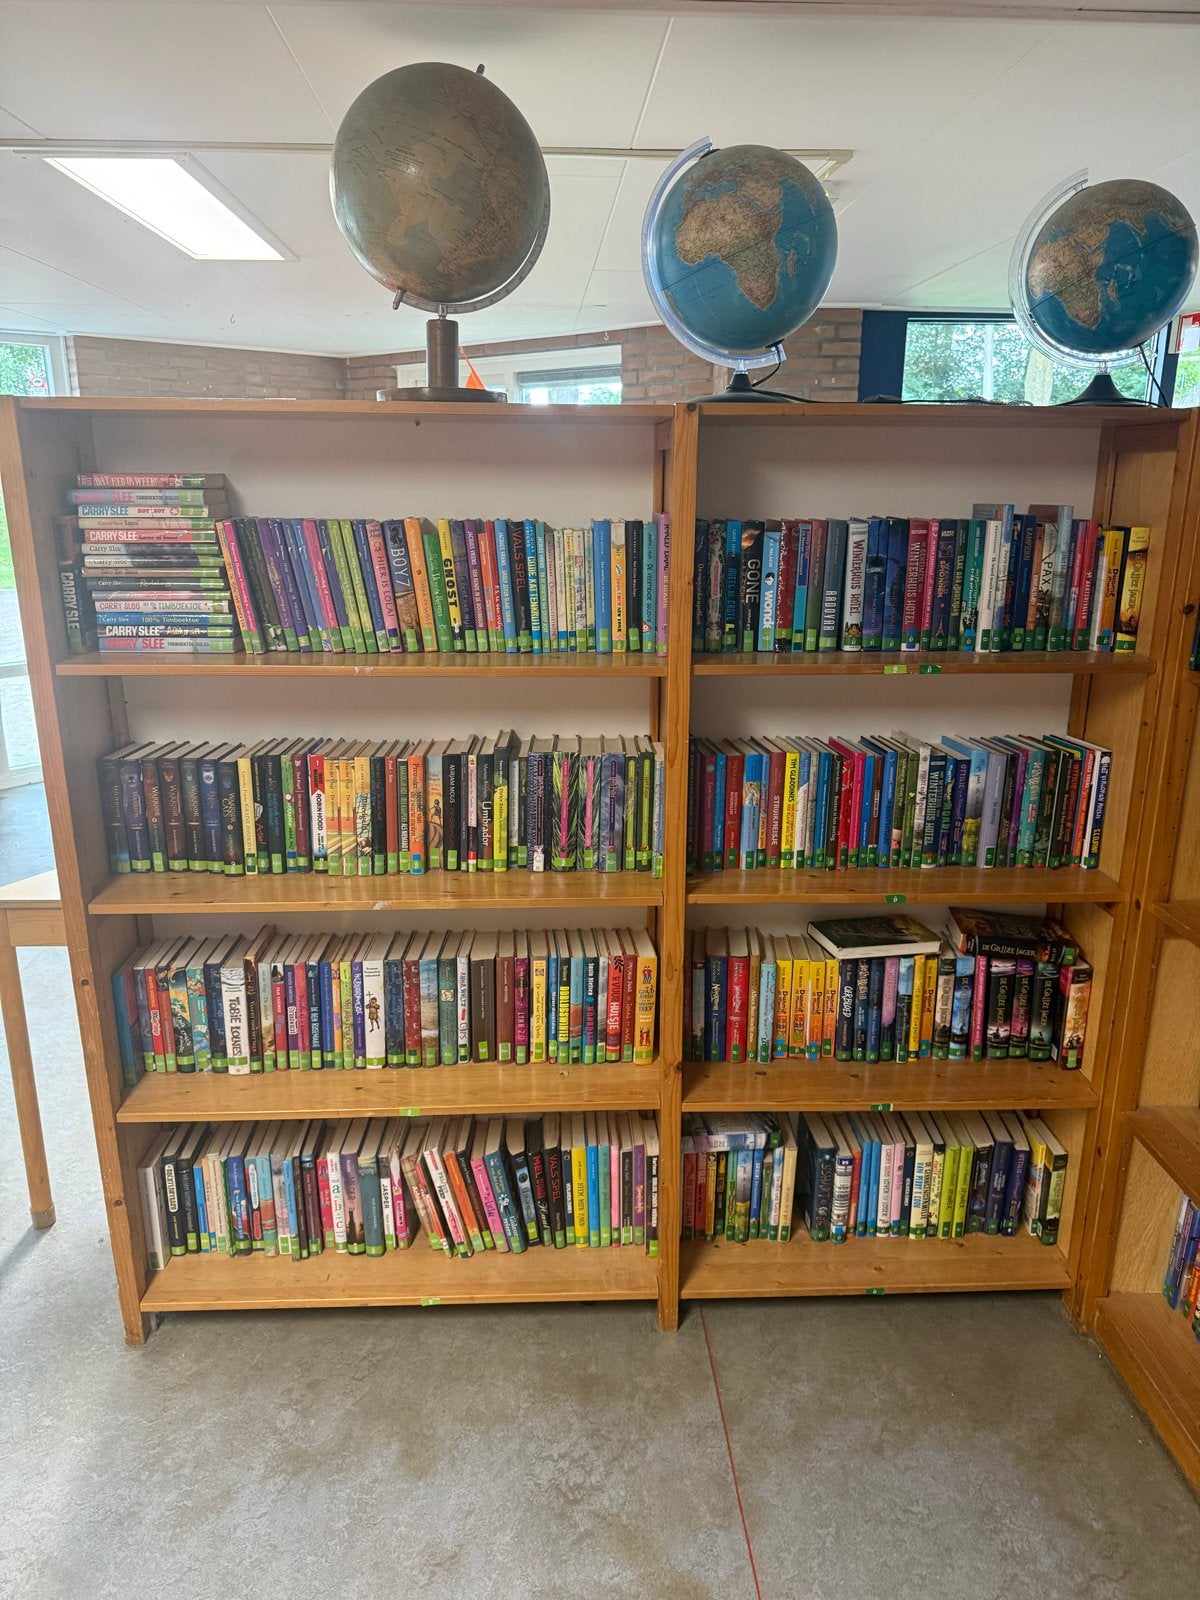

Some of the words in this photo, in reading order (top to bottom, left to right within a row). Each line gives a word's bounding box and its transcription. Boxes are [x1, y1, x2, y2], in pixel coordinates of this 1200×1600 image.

[82, 506, 110, 515] CARRY
[110, 506, 128, 515] SLEE
[90, 532, 118, 540] CARRY
[118, 532, 137, 540] SLEE
[513, 530, 523, 560] VALS
[376, 556, 386, 578] HIER
[382, 580, 389, 588] IS
[391, 548, 408, 576] BOY
[850, 540, 865, 590] WINTERHUIS
[906, 542, 920, 598] WINTERHUIS
[1041, 561, 1053, 586] PAX
[60, 572, 76, 608] CARRY
[443, 558, 457, 608] GHOST
[515, 563, 525, 593] SPEL
[746, 559, 760, 604] GONE
[850, 594, 861, 616] HOTEL
[905, 600, 915, 625] HOTEL
[64, 610, 80, 634] SLE
[106, 626, 138, 636] CARRY
[139, 626, 160, 636] SLEE
[142, 639, 165, 649] SLEE
[926, 771, 939, 821] WINTERHUIS
[482, 801, 492, 846] Umbrador
[771, 795, 780, 846] STRUIKMEISJE
[924, 823, 934, 845] HOTEL
[1017, 947, 1037, 957] JAGER
[559, 986, 570, 1042] OORLOGSWINTER
[549, 1155, 559, 1178] VALS
[552, 1179, 560, 1202] SPEL
